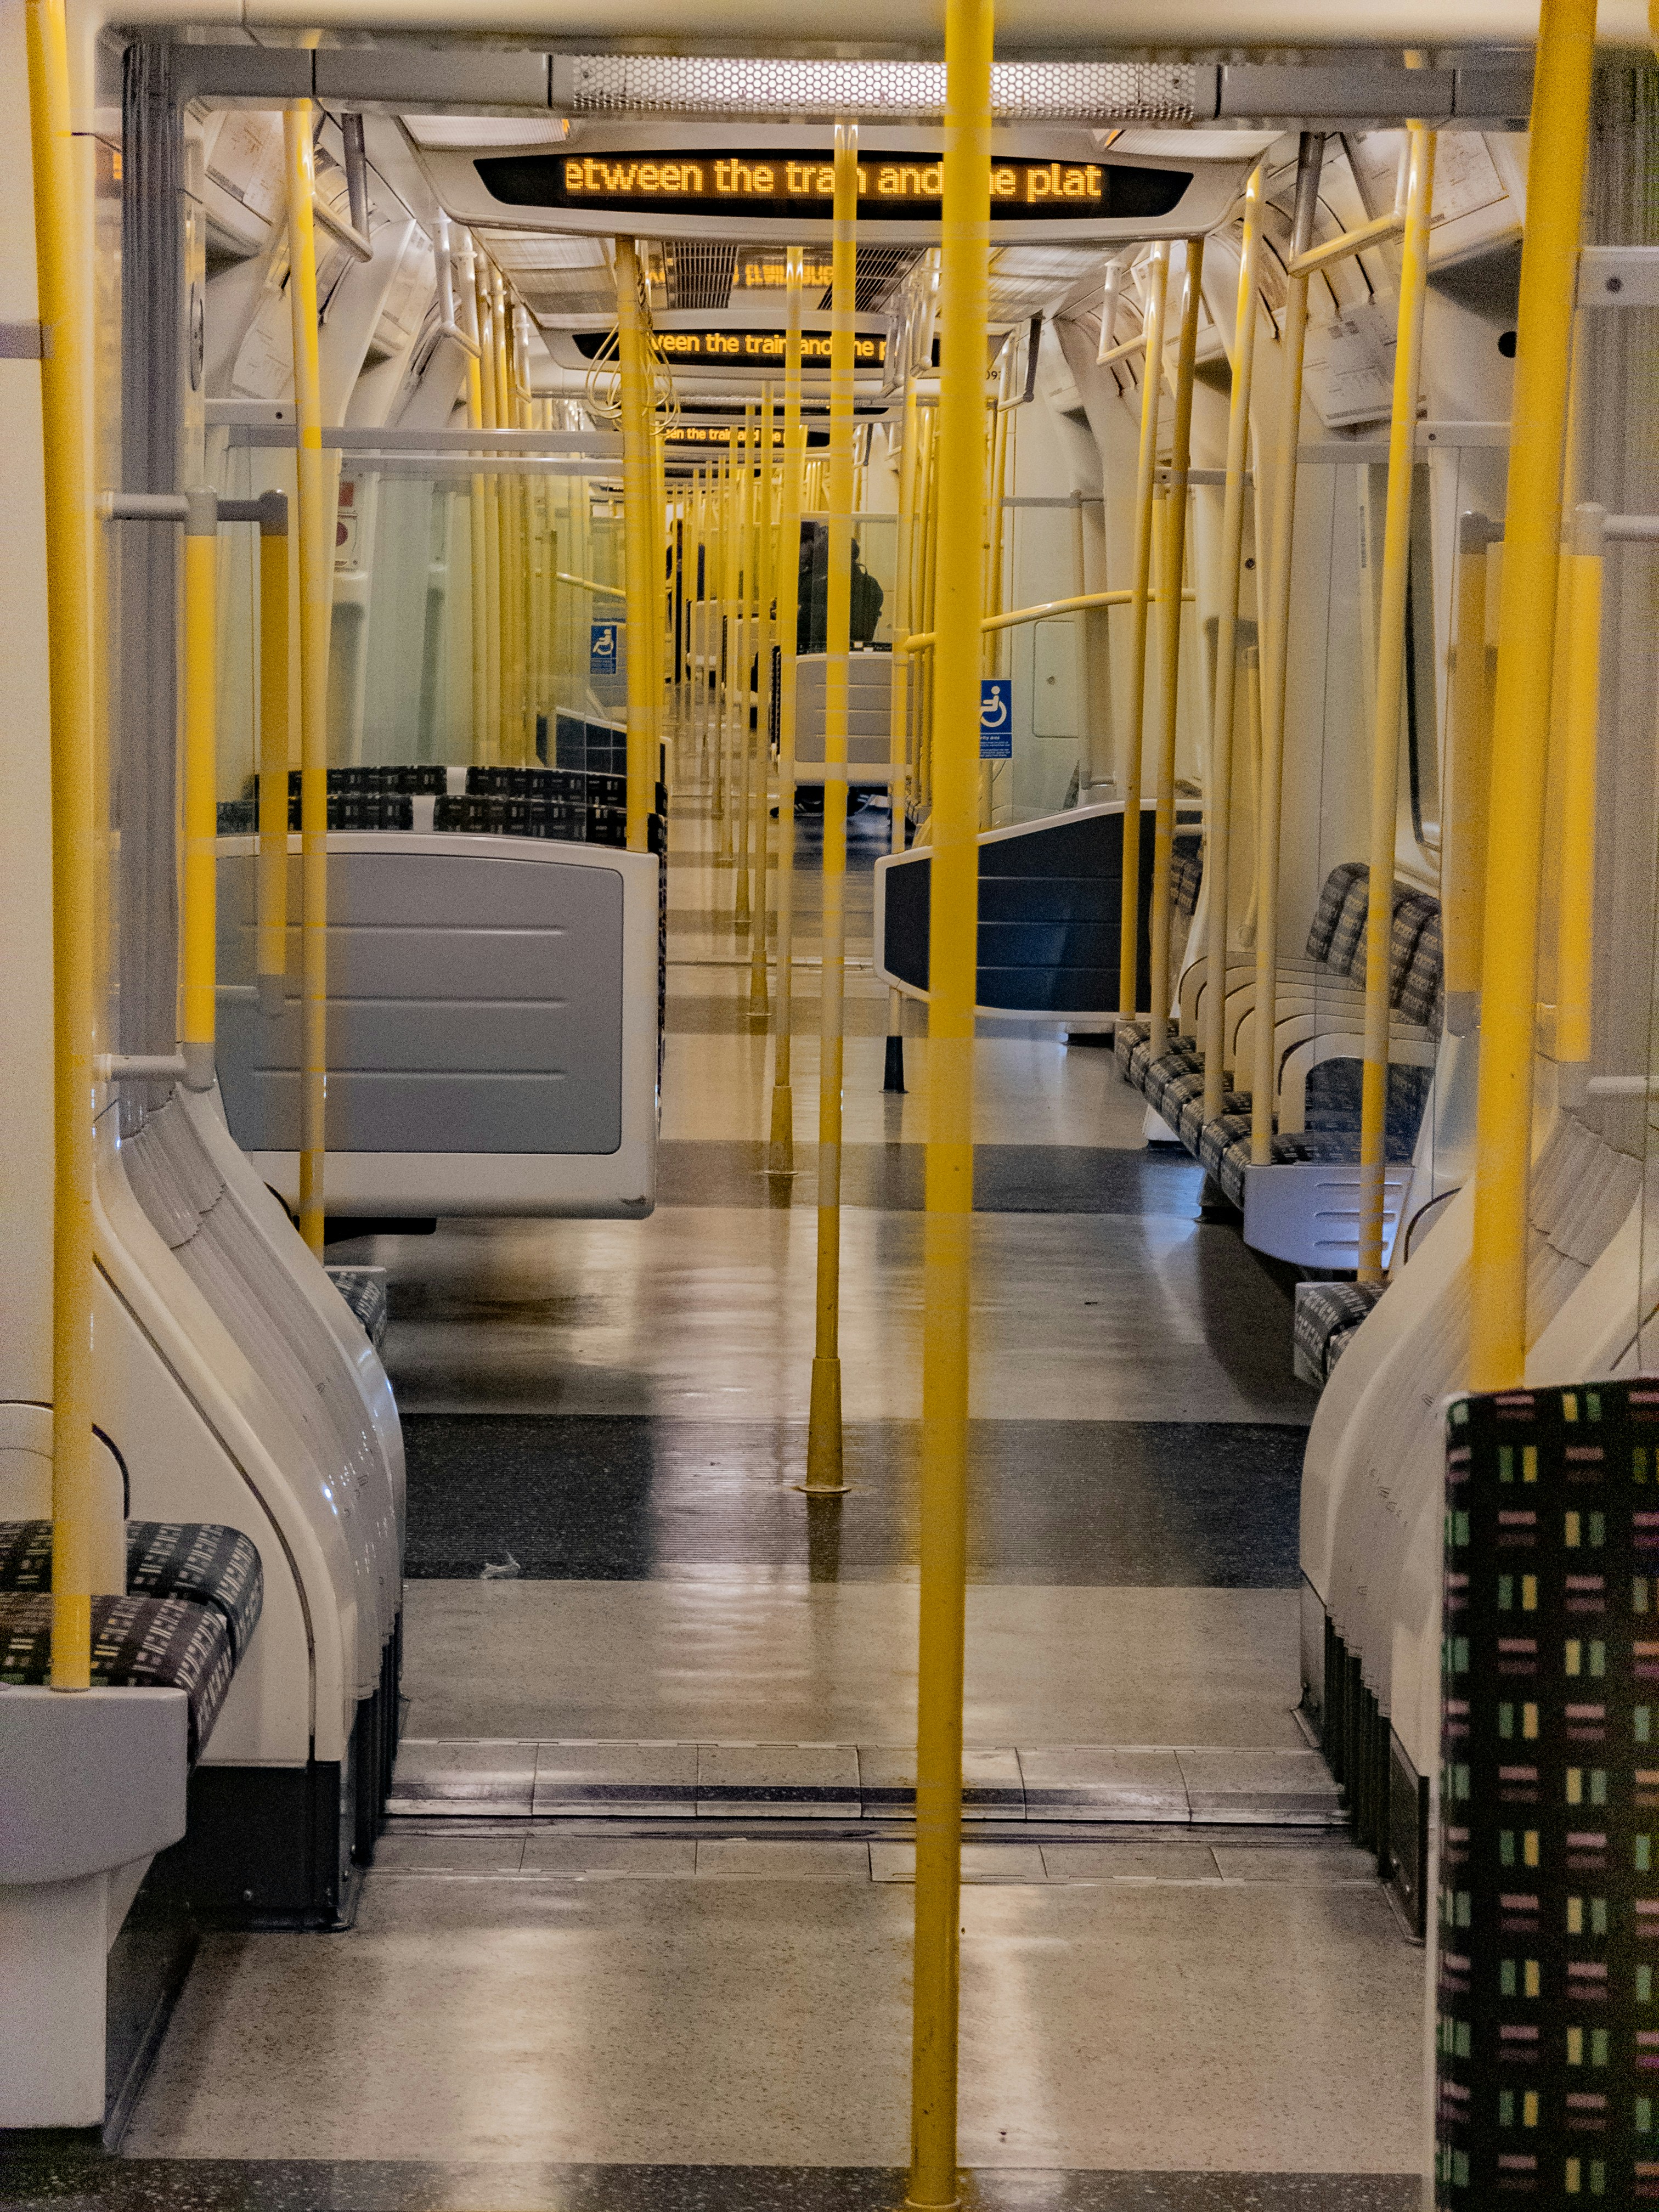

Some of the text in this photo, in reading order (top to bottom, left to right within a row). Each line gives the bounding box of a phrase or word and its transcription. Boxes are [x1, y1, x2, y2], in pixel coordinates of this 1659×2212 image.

[566, 159, 703, 190] etween
[714, 158, 775, 192] the
[786, 161, 866, 193] tran
[878, 161, 944, 194] and
[1027, 163, 1102, 202] plat
[706, 332, 740, 352] the
[686, 428, 706, 440] the
[737, 429, 759, 441] ad
